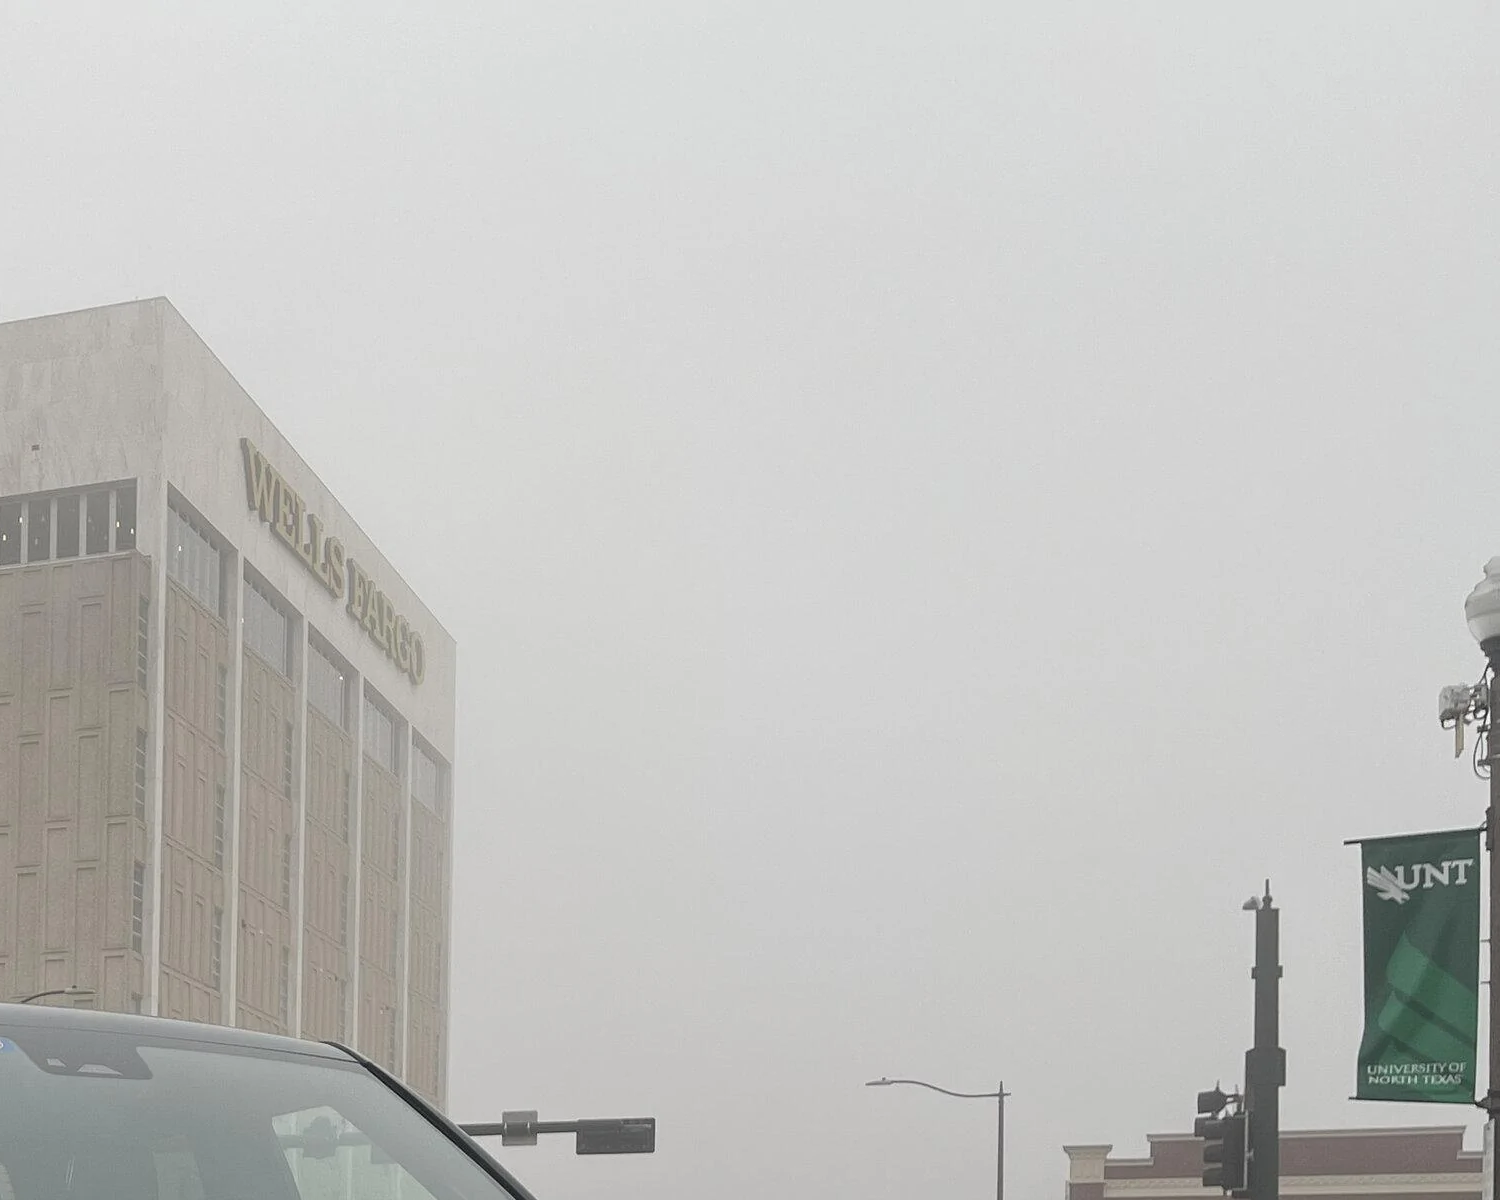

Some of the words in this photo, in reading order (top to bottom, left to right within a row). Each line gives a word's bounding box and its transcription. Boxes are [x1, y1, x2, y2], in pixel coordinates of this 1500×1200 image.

[240, 437, 345, 600] WELLS
[346, 557, 426, 685] FARGO
[1394, 859, 1474, 889] UNT
[1367, 1062, 1446, 1075] UNIVERSITY
[1448, 1062, 1466, 1072] OF
[1368, 1074, 1417, 1085] NORTH
[1423, 1074, 1462, 1085] TEXAS
